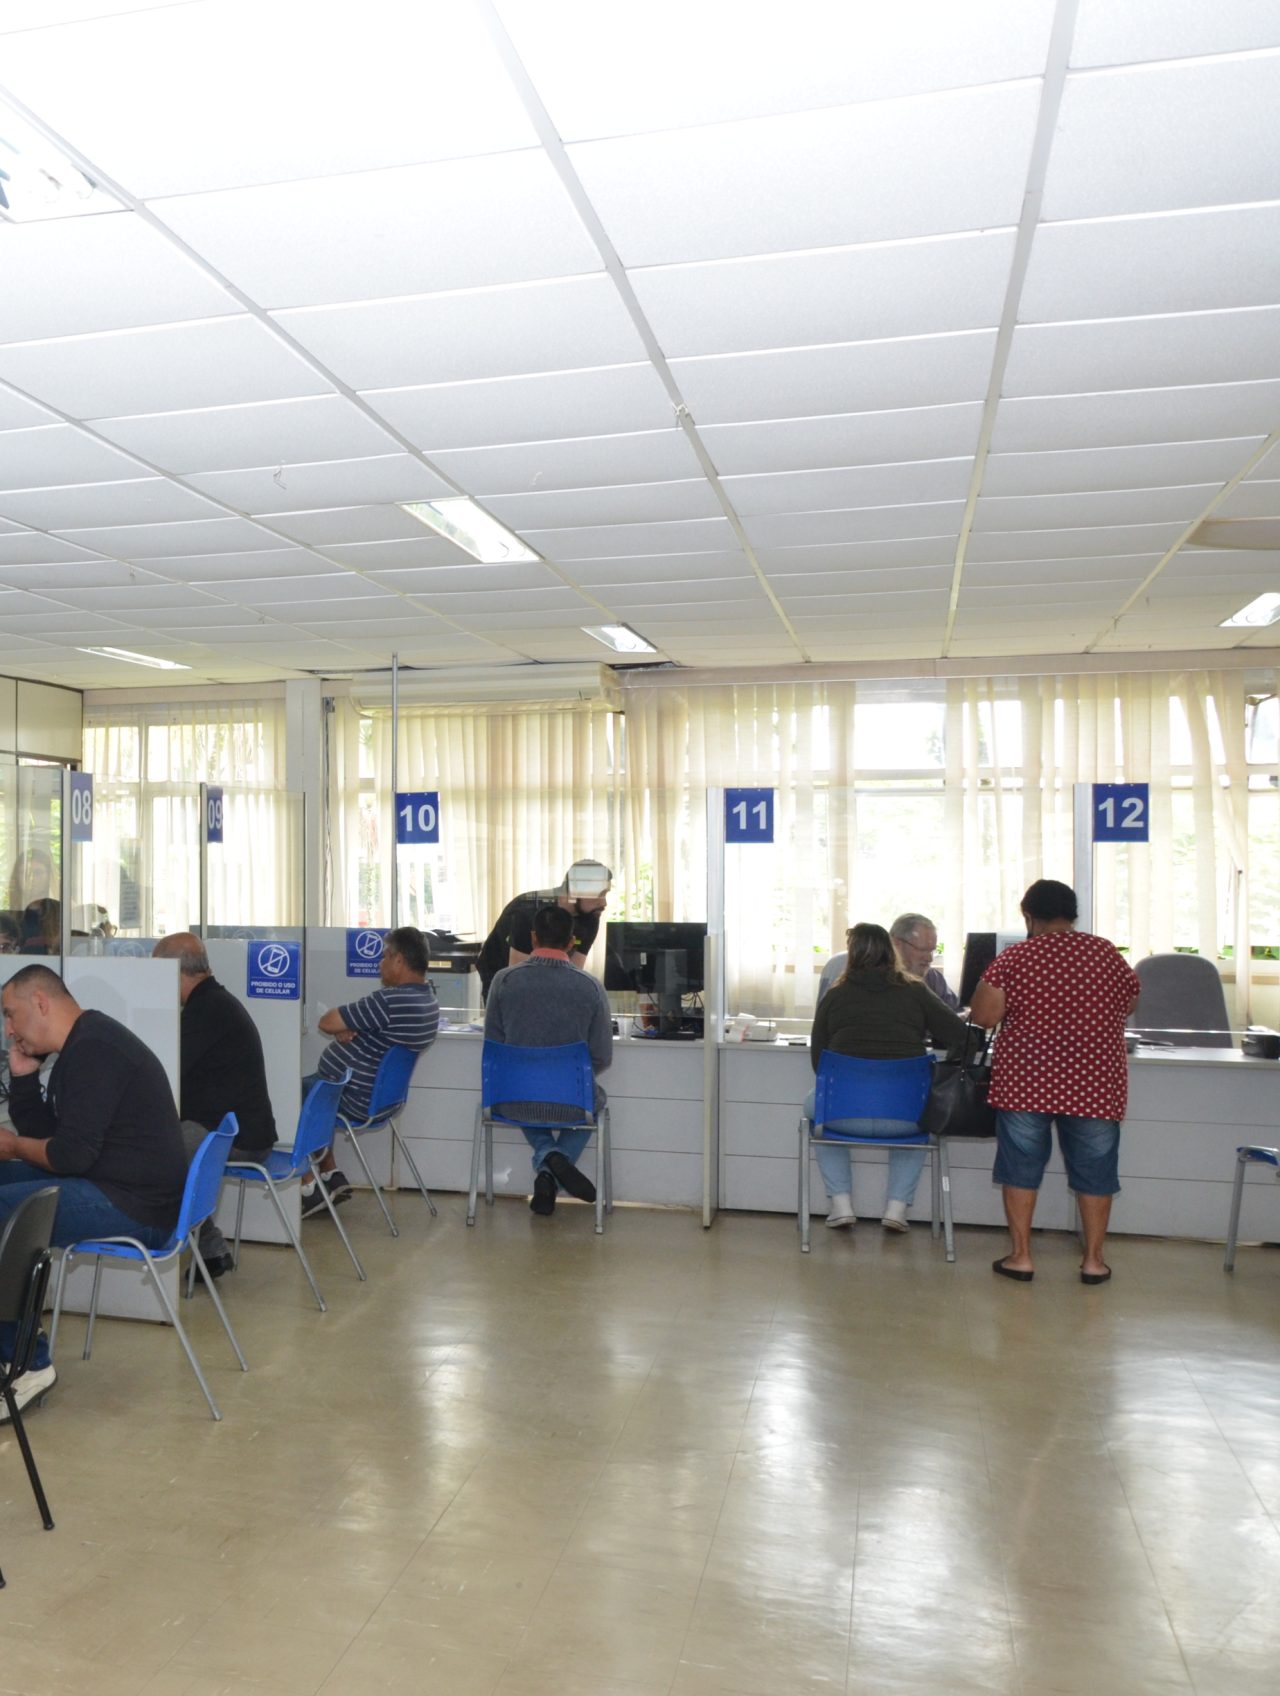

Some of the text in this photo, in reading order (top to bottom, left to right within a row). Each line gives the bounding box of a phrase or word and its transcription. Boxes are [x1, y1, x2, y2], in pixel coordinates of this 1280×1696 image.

[72, 789, 92, 826] 08
[208, 799, 222, 830] 09
[400, 804, 436, 832] 10
[732, 801, 767, 830] 11
[1098, 797, 1144, 828] 12
[265, 987, 290, 995] CELULAR
